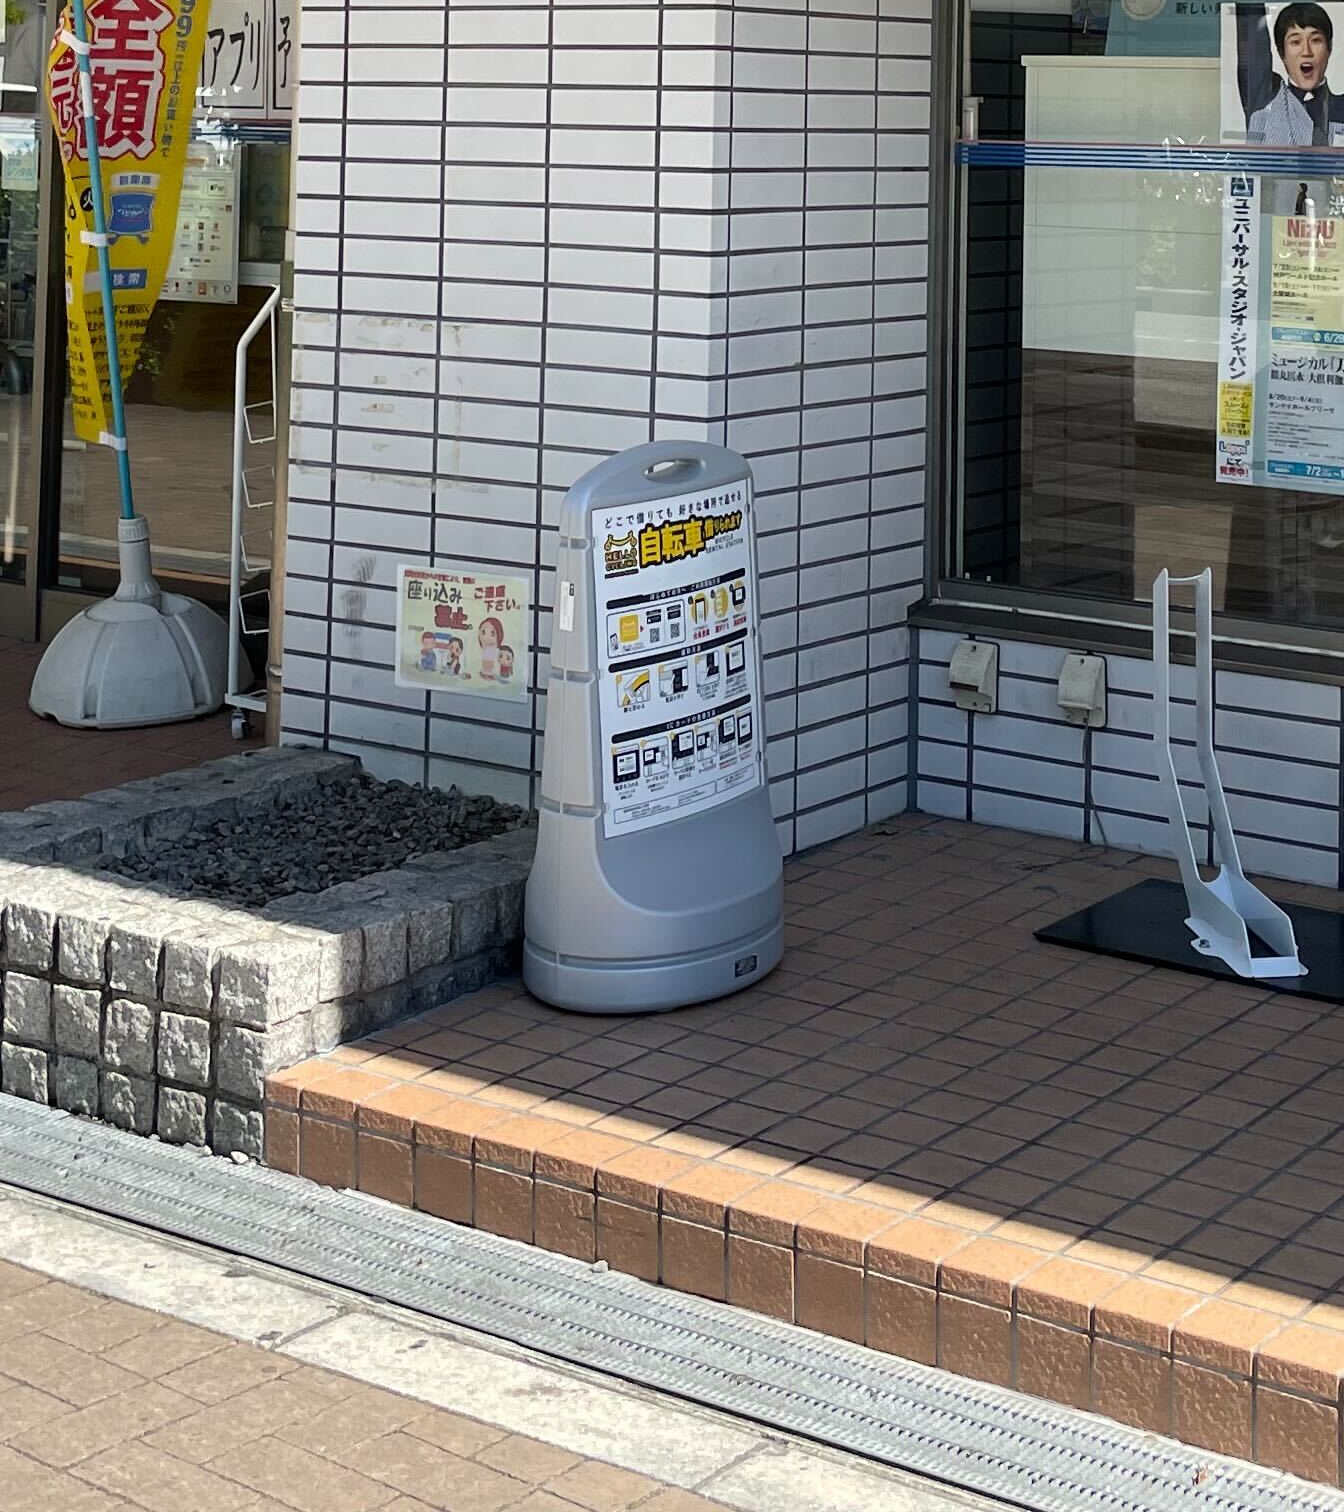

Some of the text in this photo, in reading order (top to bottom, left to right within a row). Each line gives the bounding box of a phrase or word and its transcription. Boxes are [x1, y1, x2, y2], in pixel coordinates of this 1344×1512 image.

[1228, 197, 1252, 380] ユニバーサル・スタジオ・ジャパン
[605, 490, 743, 529] どこで借りても 好きな場所で返せる
[408, 580, 462, 604] 座り込み
[484, 598, 521, 613] 下さい。
